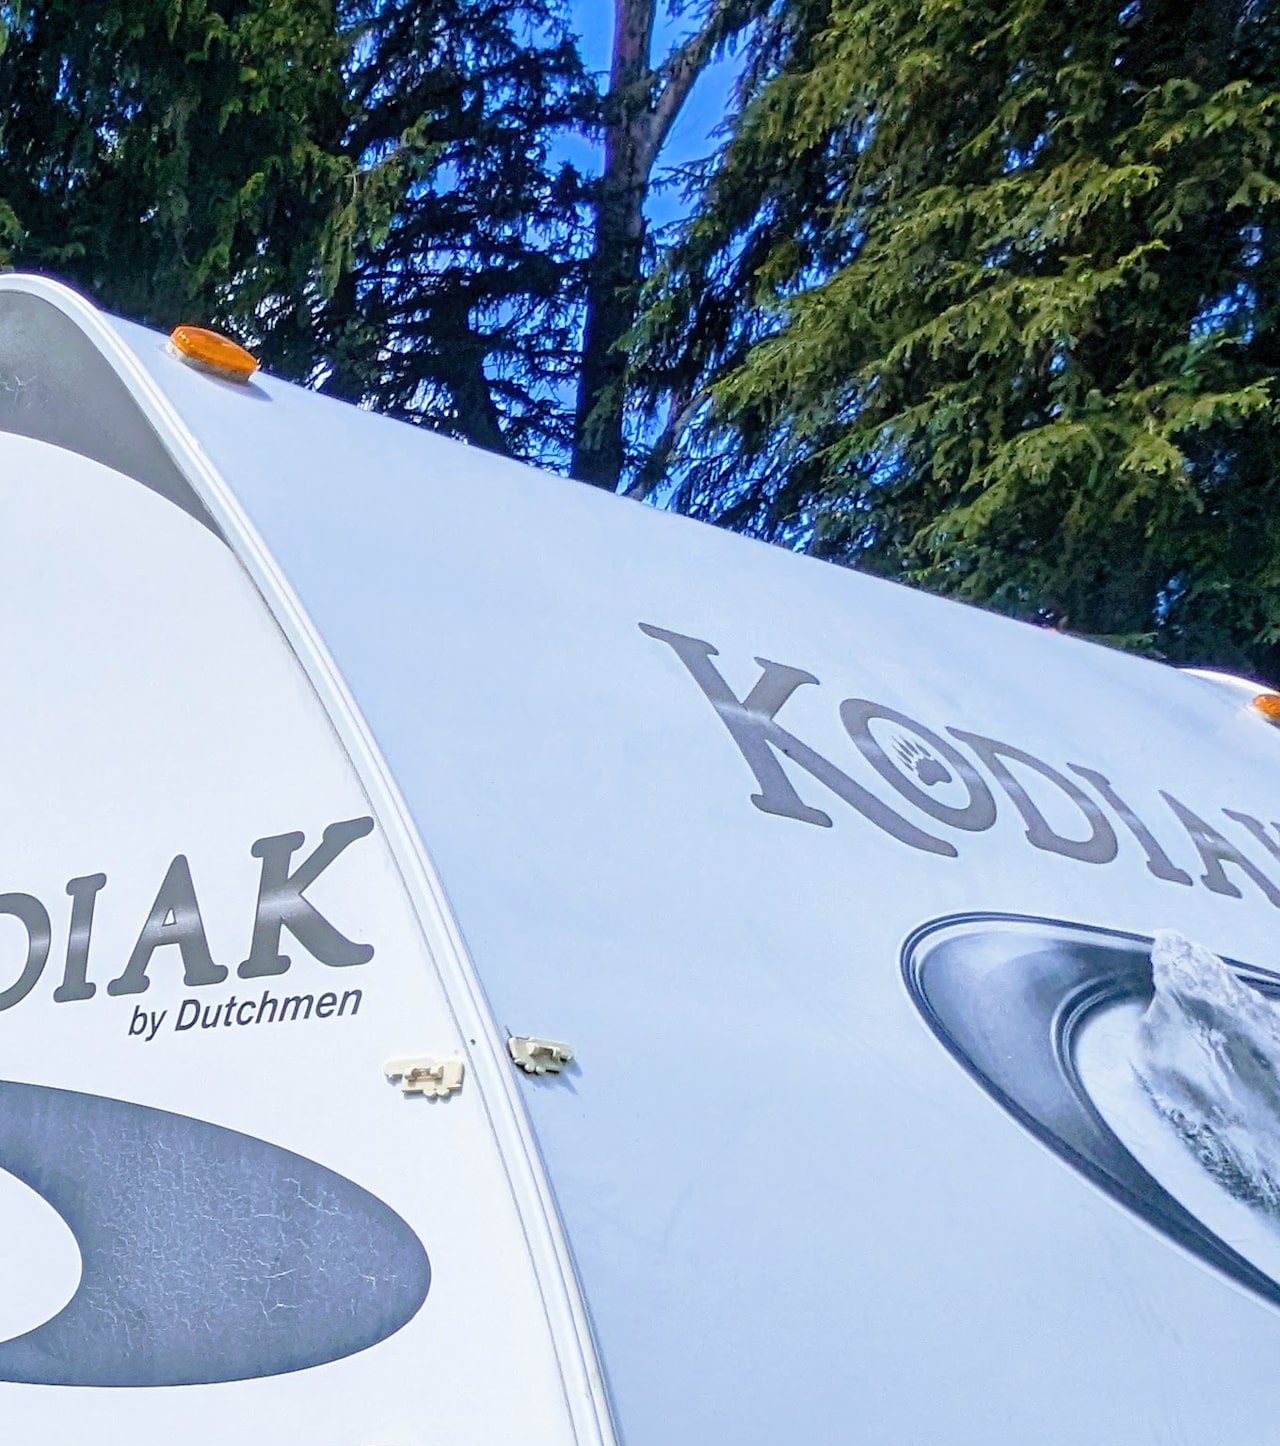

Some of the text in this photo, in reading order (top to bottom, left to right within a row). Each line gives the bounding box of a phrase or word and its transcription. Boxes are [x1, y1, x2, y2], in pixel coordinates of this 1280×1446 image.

[638, 622, 1280, 909] KODIA
[128, 989, 362, 1042] by Dutchmen
